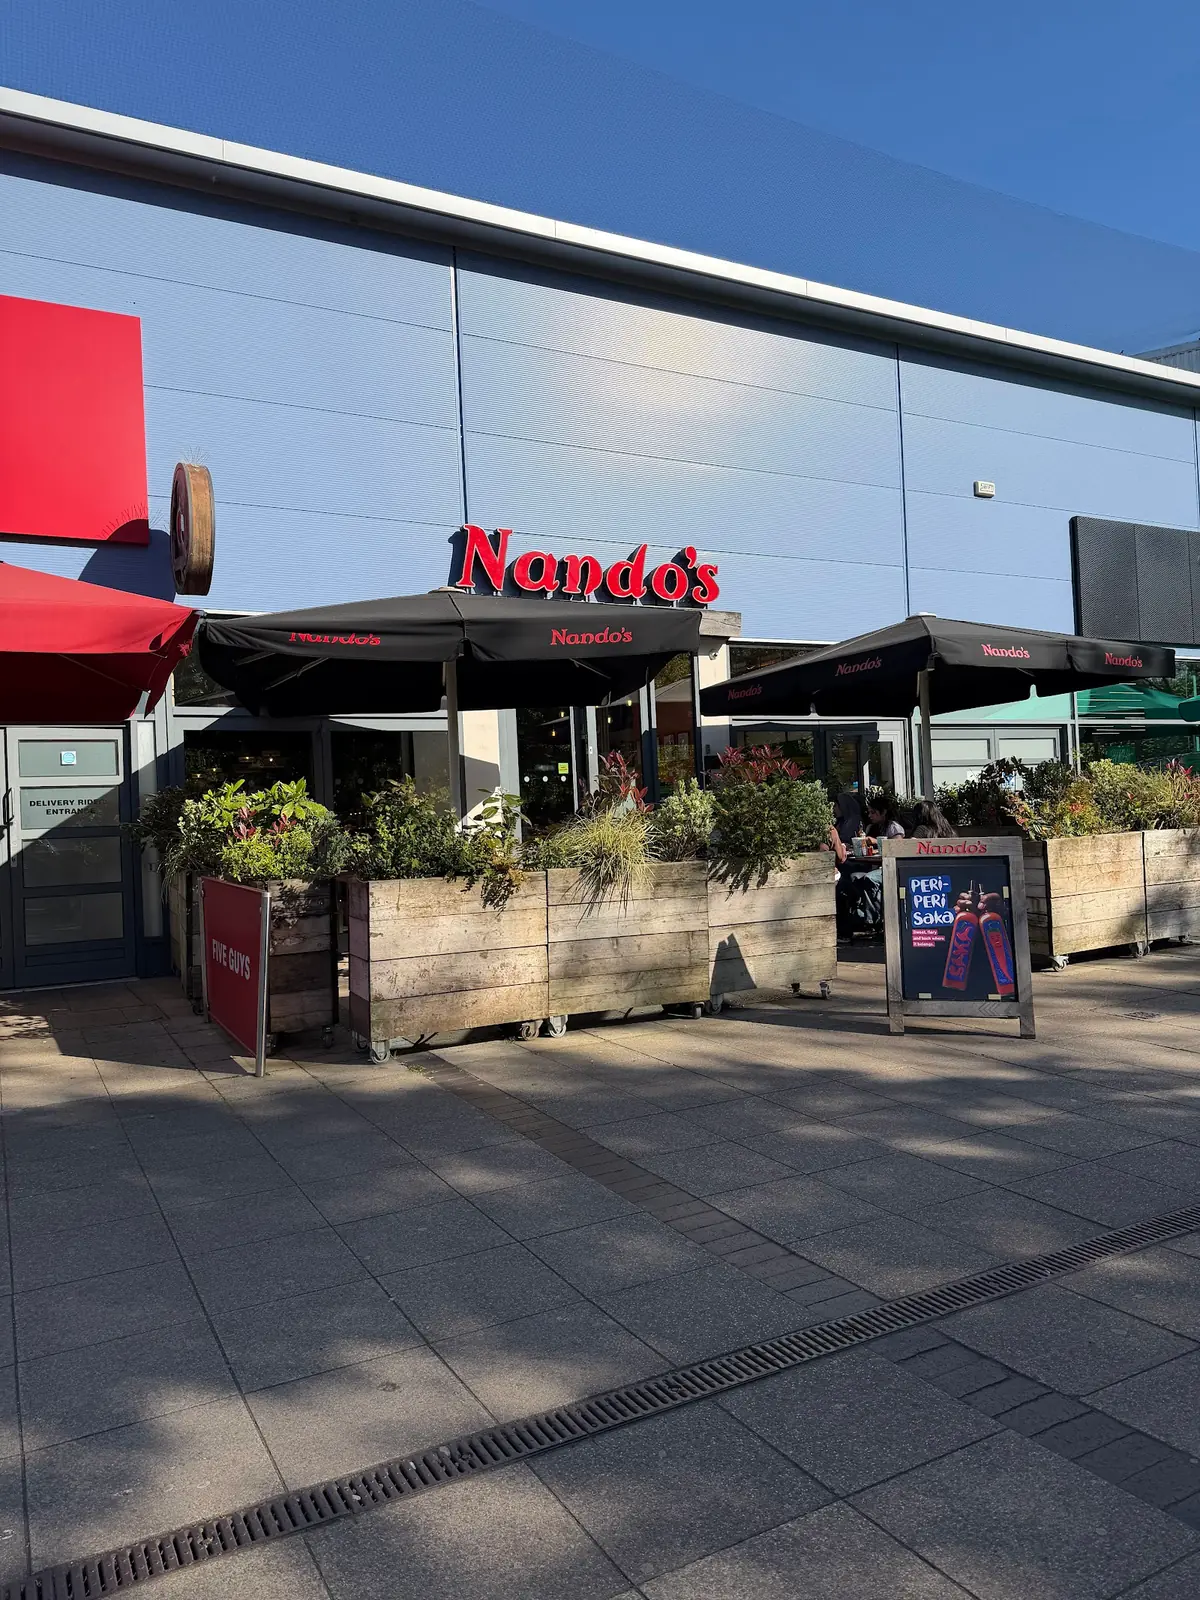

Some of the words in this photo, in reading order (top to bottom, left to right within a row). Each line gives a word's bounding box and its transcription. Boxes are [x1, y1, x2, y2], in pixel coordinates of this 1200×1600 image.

[456, 524, 720, 604] Nando's
[550, 627, 633, 646] Nando's
[981, 643, 1030, 659] Nando's
[835, 656, 882, 677] Nando's
[1104, 652, 1143, 668] Nando's
[727, 684, 763, 700] Nando's
[29, 799, 75, 807] DELIVERY
[916, 840, 988, 855] Nando's
[913, 910, 955, 926] Saka
[212, 938, 227, 967] FIVE
[229, 947, 251, 980] GUYS
